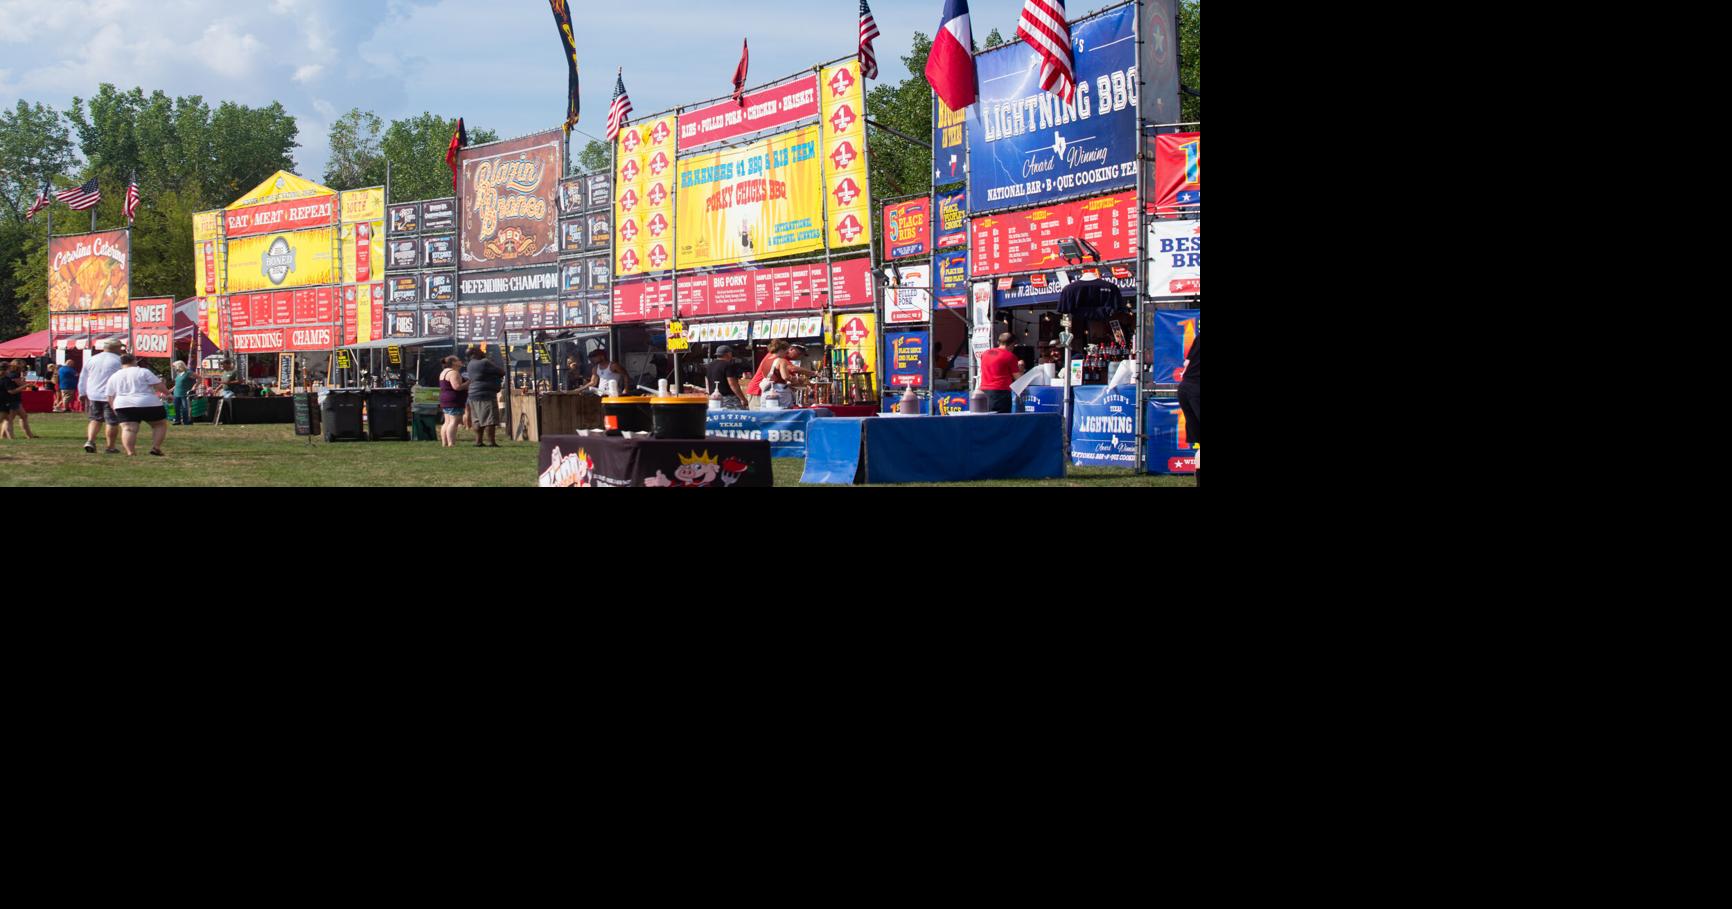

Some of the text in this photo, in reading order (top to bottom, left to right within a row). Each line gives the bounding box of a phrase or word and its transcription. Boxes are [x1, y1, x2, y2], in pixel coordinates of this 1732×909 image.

[701, 115, 724, 133] PULLED
[725, 109, 742, 127] PORK
[747, 100, 777, 120] CHICKEN
[782, 88, 814, 112] BRISKET
[983, 81, 1091, 143] LIGHTNING
[747, 155, 763, 177] BBQ
[773, 147, 789, 169] RIB
[1023, 146, 1108, 178] Award Winning
[987, 182, 1026, 202] NATIONAL
[1075, 165, 1119, 186] COOKING
[706, 184, 734, 213] PORKY
[769, 178, 788, 200] BBQ
[228, 214, 249, 229] EAT
[254, 209, 284, 226] MEAT
[289, 203, 331, 221] REPEAT
[898, 213, 924, 230] PLACE
[898, 226, 916, 241] RIBS
[54, 238, 125, 272] Carolina Catering
[462, 277, 509, 294] DEFENDING
[510, 272, 558, 291] CHAMPION
[713, 277, 725, 288] BIG
[725, 274, 747, 288] PORKY
[134, 303, 168, 323] SWEET
[135, 334, 168, 352] CORN
[234, 329, 330, 349] DEFENDING CHAMPS
[1079, 415, 1132, 433] LIGHTNING
[768, 429, 805, 443] BBQ
